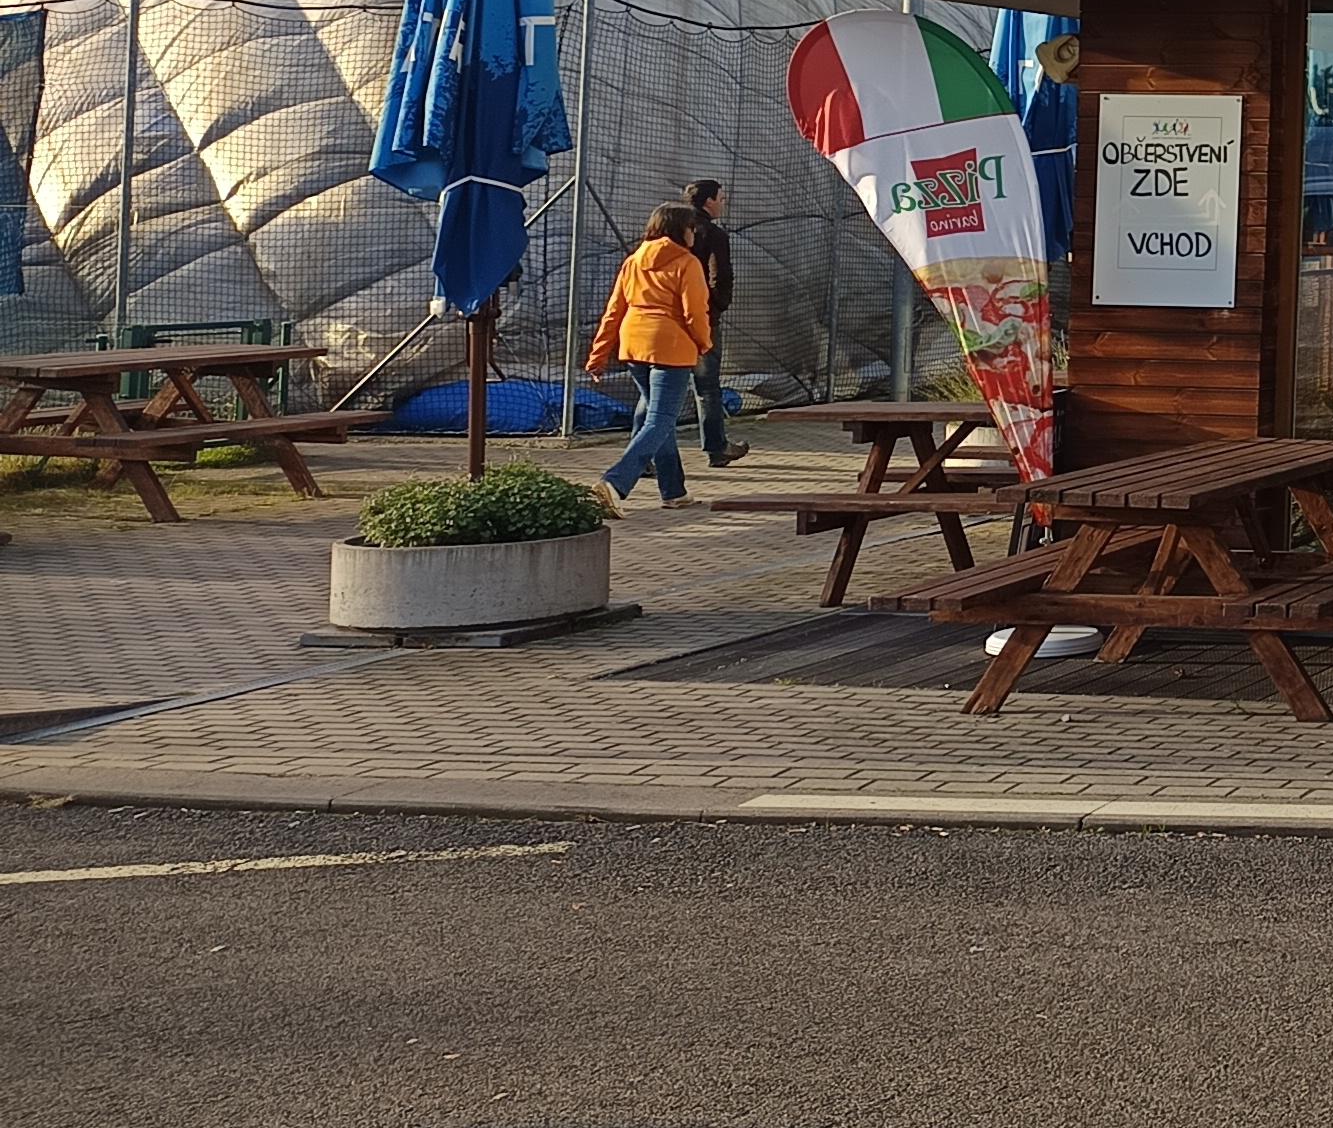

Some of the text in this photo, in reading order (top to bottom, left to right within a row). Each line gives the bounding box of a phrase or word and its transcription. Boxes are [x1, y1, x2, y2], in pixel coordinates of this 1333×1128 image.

[1102, 136, 1234, 165] OBČERSTVENÍ
[1130, 167, 1189, 197] ZDE
[1127, 232, 1212, 258] VCHOD
